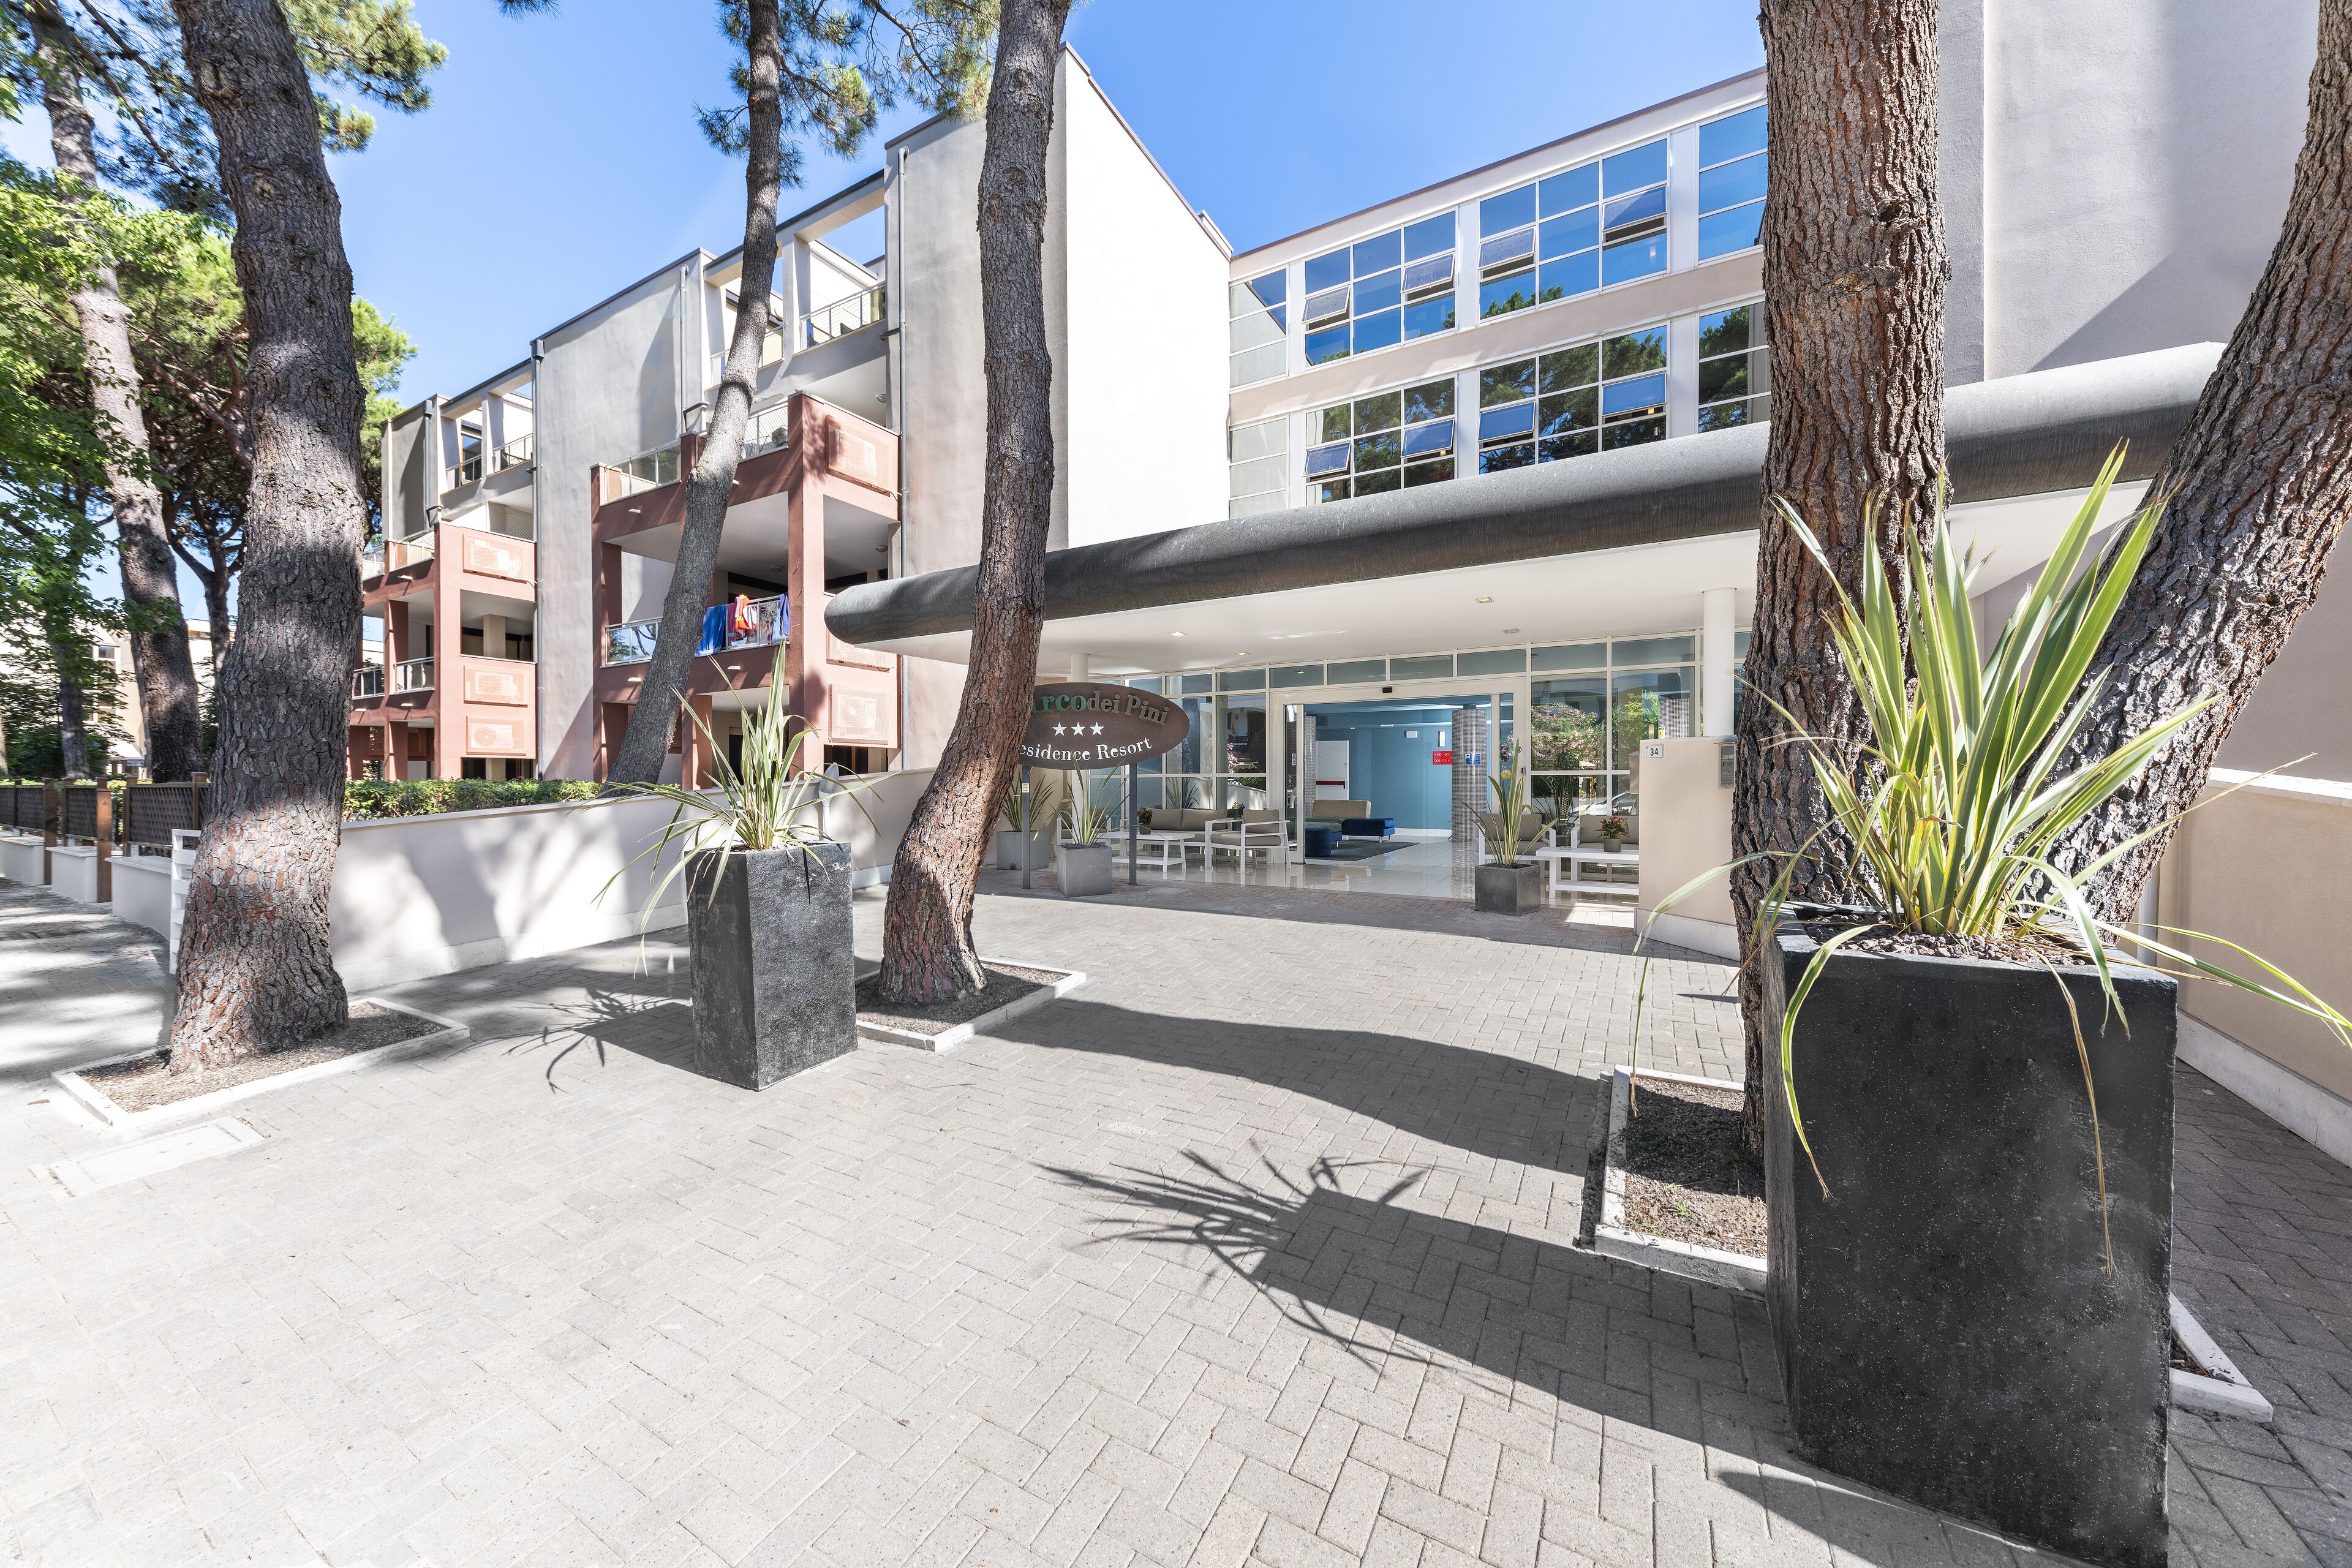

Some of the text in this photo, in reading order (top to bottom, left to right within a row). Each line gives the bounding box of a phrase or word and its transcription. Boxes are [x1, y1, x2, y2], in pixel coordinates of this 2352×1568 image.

[1125, 695, 1169, 725] Pini
[1019, 737, 1152, 761] esidence Resort
